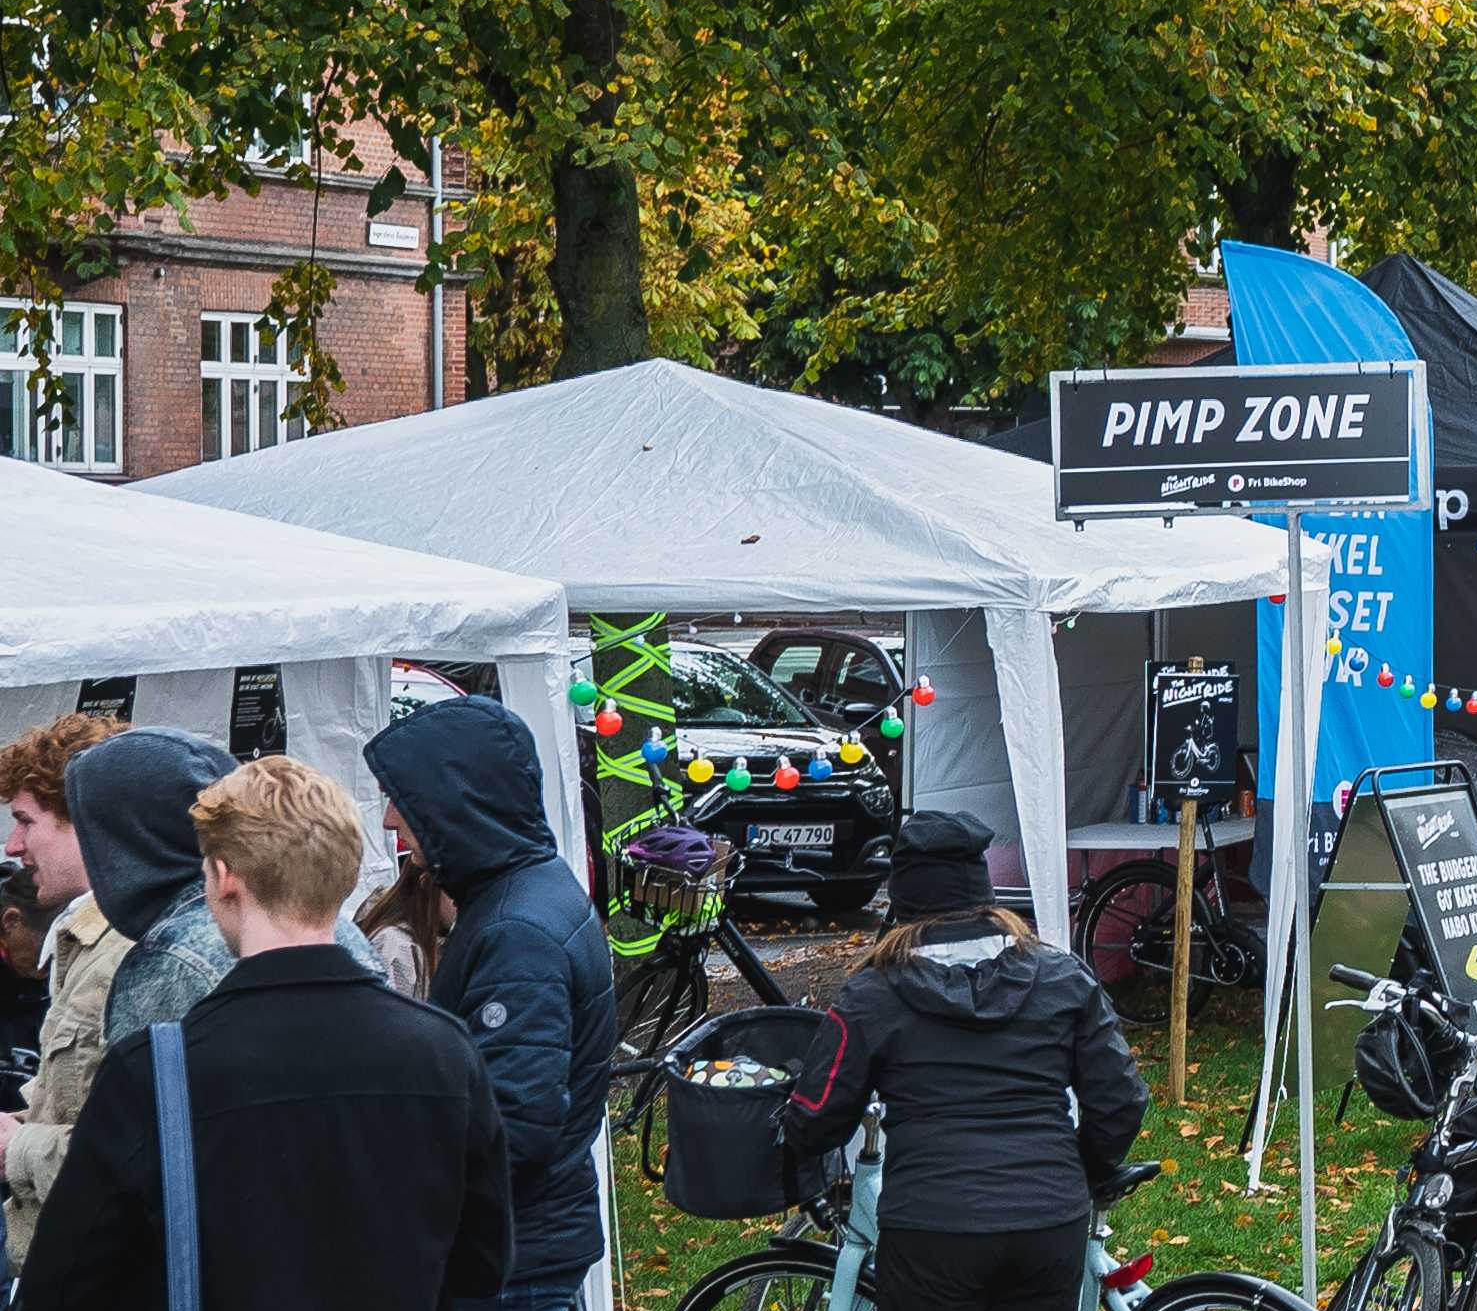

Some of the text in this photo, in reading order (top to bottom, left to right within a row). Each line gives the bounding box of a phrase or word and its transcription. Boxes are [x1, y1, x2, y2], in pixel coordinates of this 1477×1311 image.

[1102, 394, 1370, 448] PIMP ZONE
[1248, 476, 1307, 488] Fri BikeShop
[1328, 590, 1394, 633] SET
[759, 827, 832, 844] DC 47 790
[1307, 832, 1319, 853] ri
[1417, 861, 1437, 886] THE
[1440, 915, 1468, 940] NABO
